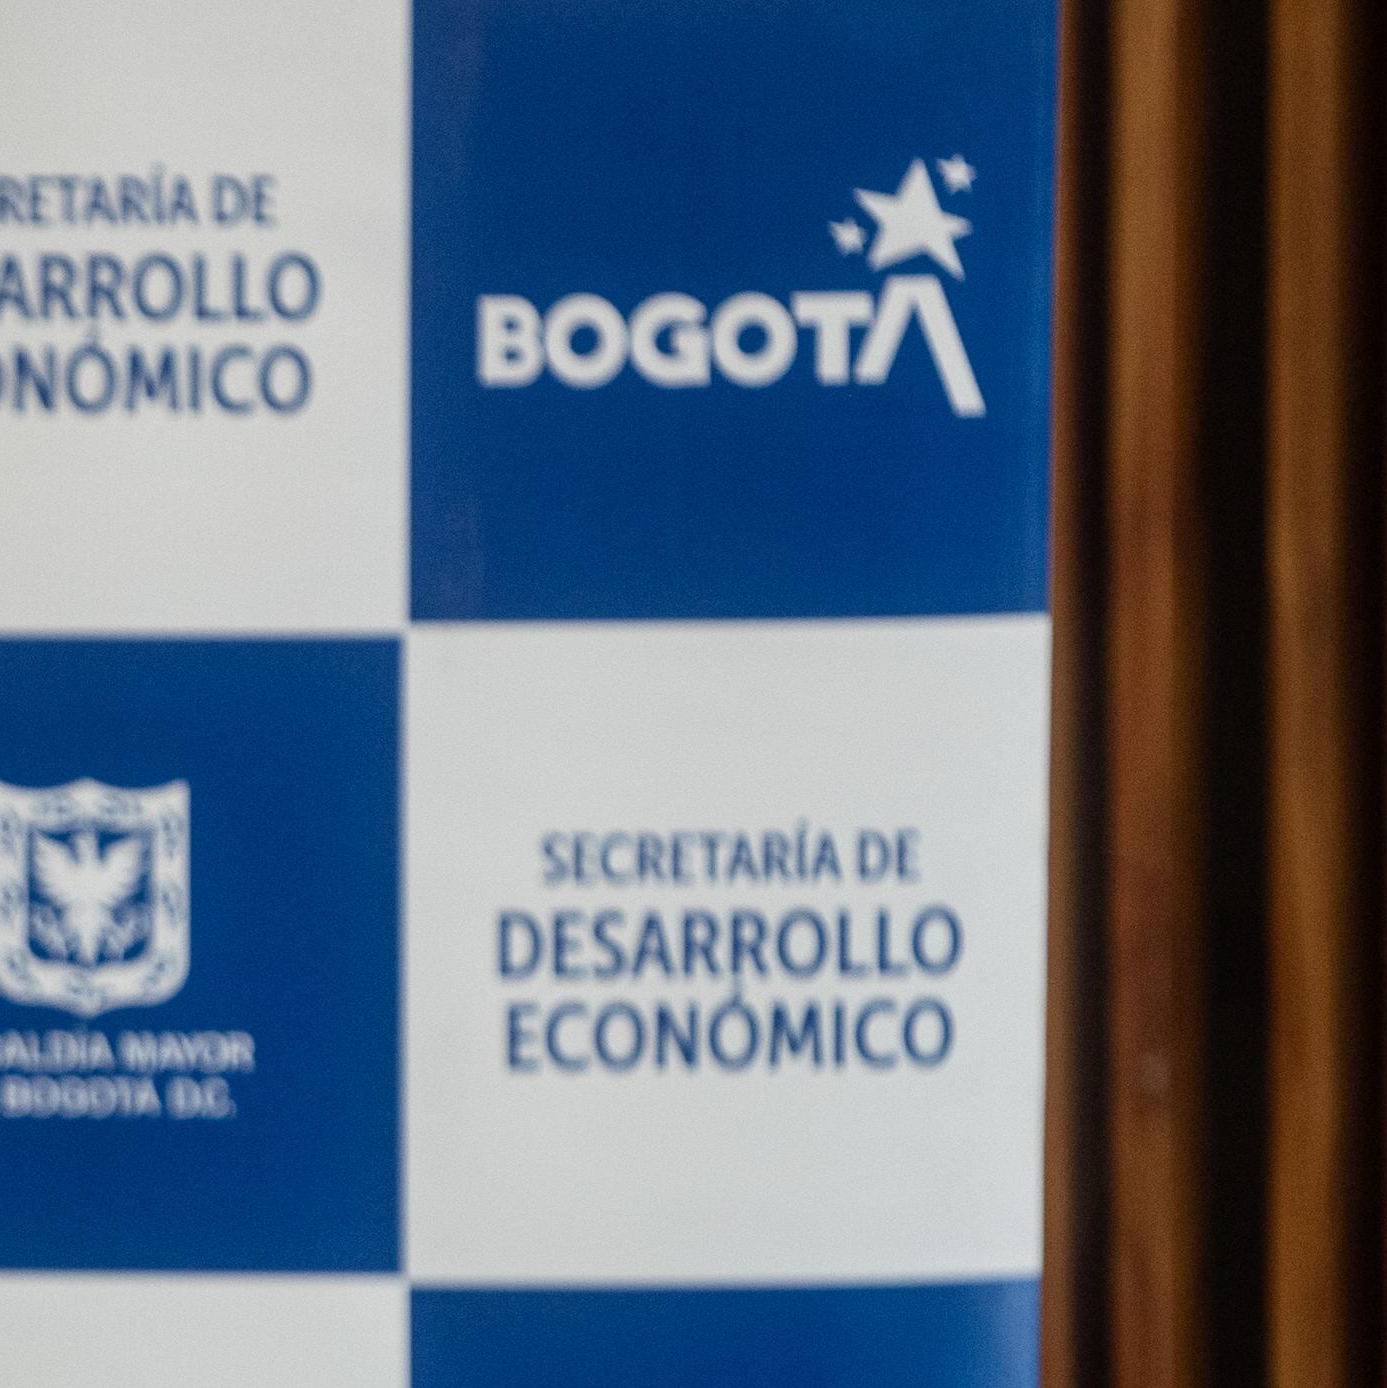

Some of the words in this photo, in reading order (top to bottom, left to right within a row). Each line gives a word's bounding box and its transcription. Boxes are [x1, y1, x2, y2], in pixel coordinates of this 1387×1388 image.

[209, 175, 277, 228] DE
[540, 817, 844, 885] SECRETARÍA
[855, 828, 920, 884] DE
[496, 904, 965, 980] DESARROLLO
[117, 1031, 255, 1073] MAYOR
[504, 977, 956, 1072] ECONÓMICO
